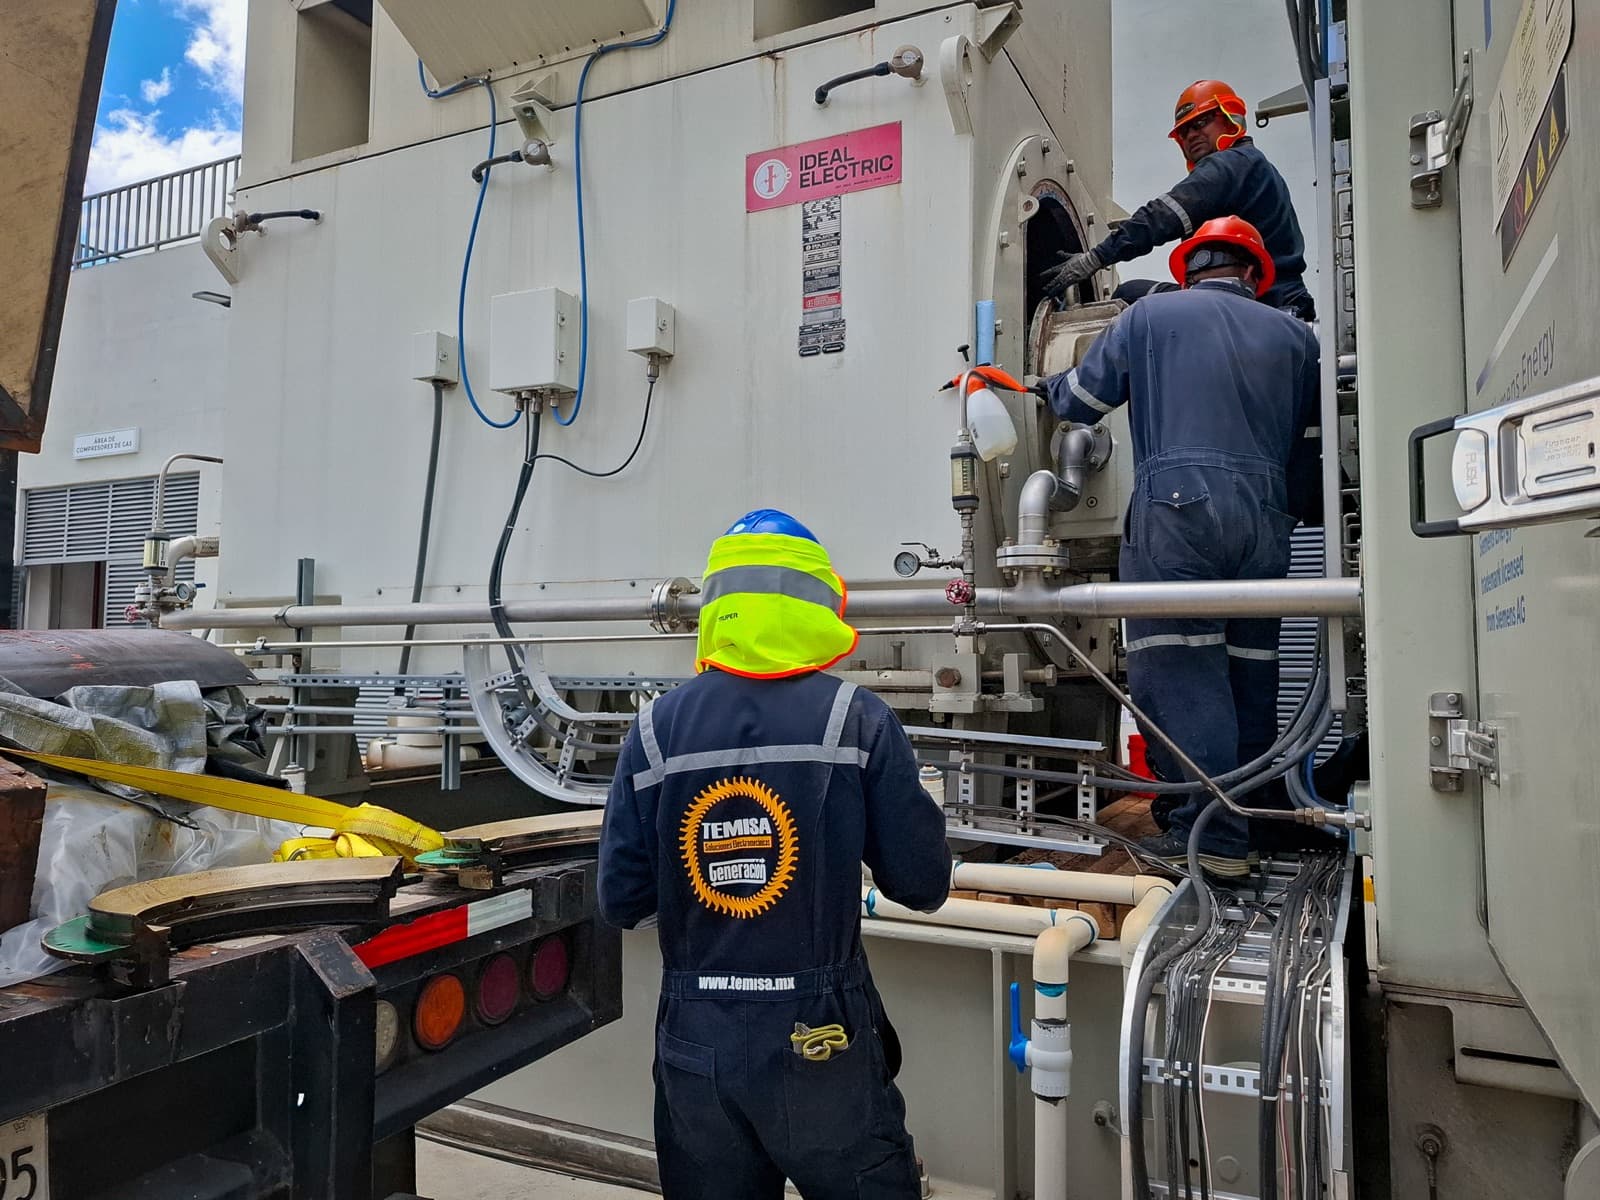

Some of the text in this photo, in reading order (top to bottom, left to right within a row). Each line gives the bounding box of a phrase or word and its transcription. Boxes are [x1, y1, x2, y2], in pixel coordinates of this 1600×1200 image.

[800, 147, 855, 171] IDEAL
[800, 155, 894, 189] ELECTRIC
[1521, 319, 1555, 392] Energy
[76, 443, 114, 453] COMPRESORES
[1465, 452, 1478, 487] PUSH
[1501, 544, 1524, 585] licensed
[1496, 603, 1516, 631] Siemens
[1517, 595, 1526, 625] AG
[701, 818, 772, 839] TEMISA
[705, 842, 732, 851] Soluciones
[699, 976, 795, 991] www.temisa.mx
